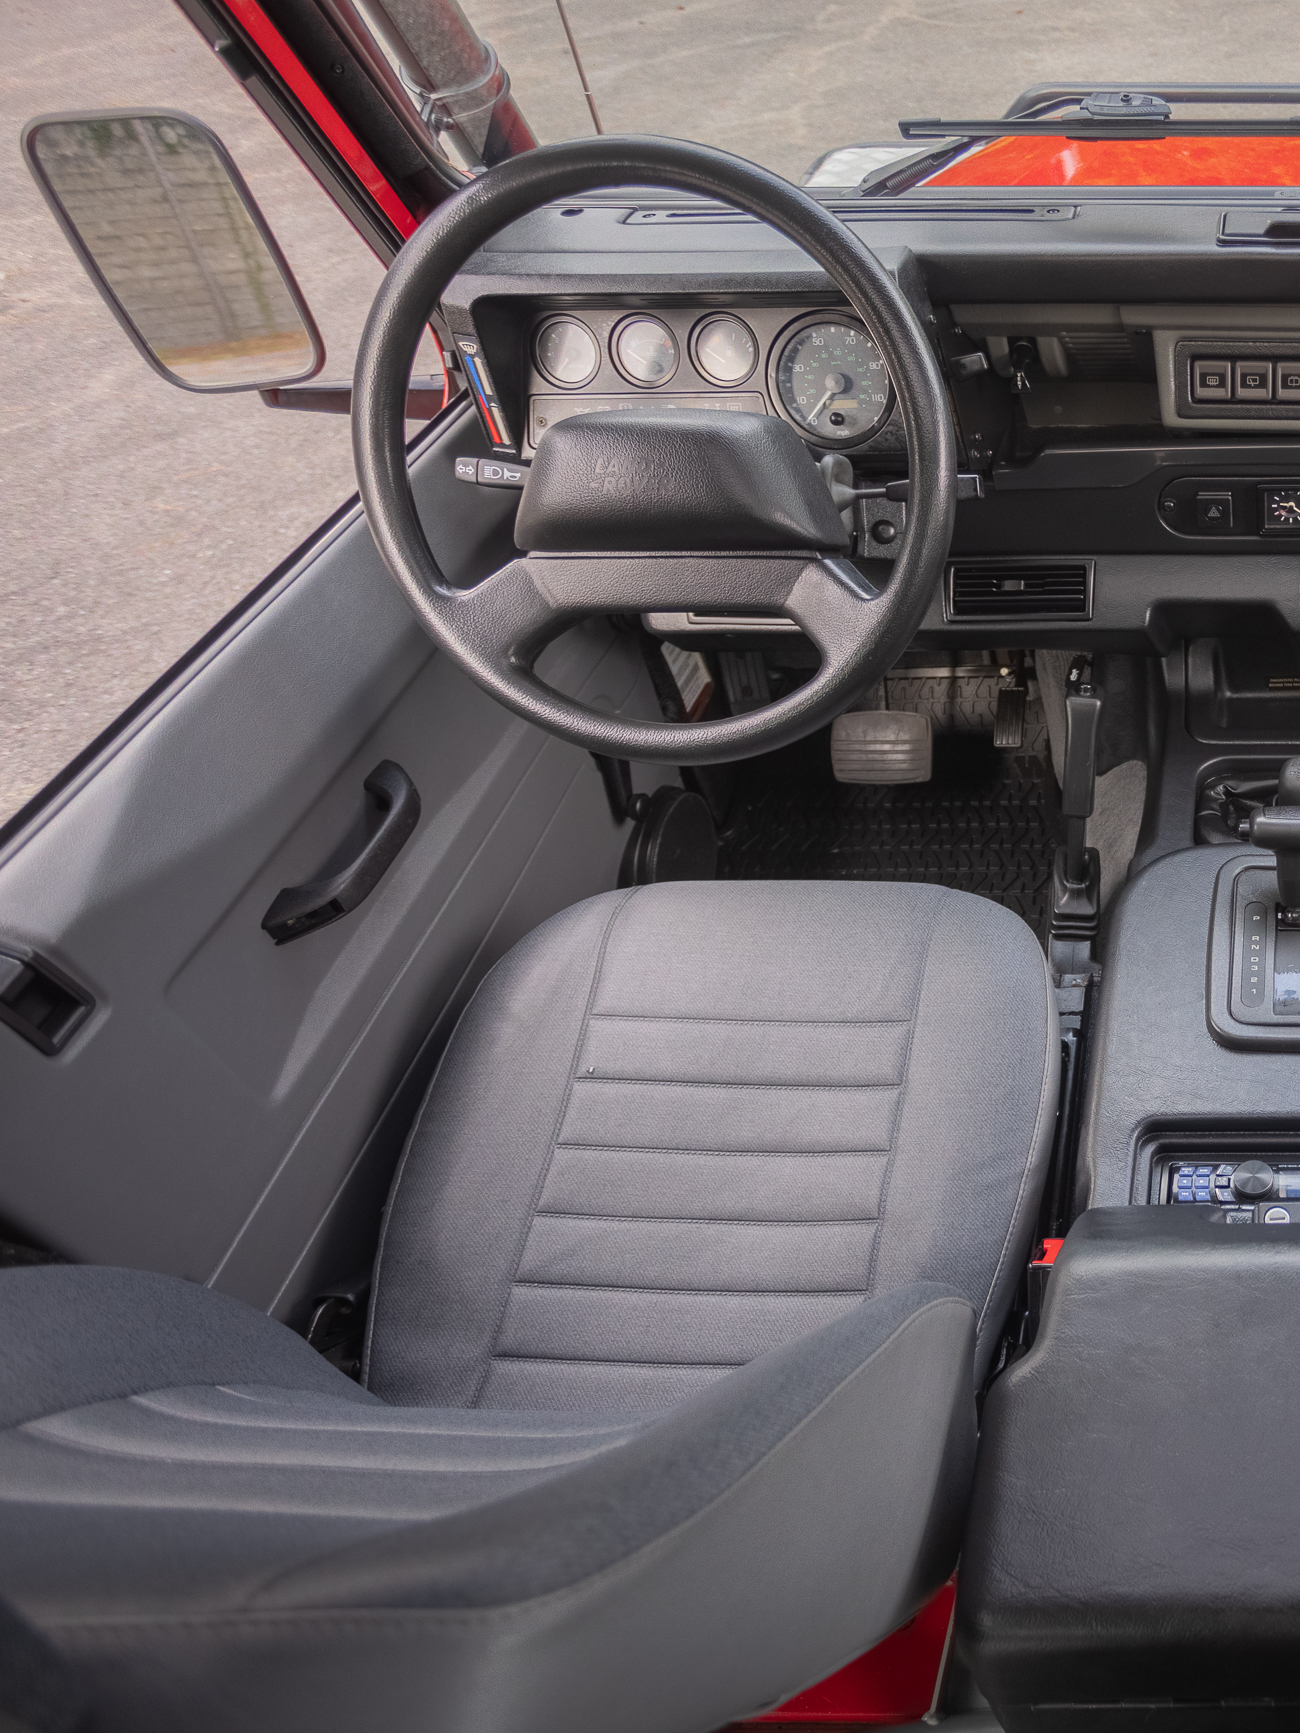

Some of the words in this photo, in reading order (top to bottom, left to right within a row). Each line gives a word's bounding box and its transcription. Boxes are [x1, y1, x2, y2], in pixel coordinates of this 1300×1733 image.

[812, 338, 824, 346] 50
[844, 337, 856, 345] 70
[792, 364, 804, 372] 30
[869, 362, 881, 370] 90
[796, 396, 807, 404] 10
[871, 394, 884, 402] 110
[811, 417, 818, 425] 0
[594, 457, 653, 474] LAND
[603, 476, 674, 494] ROVER
